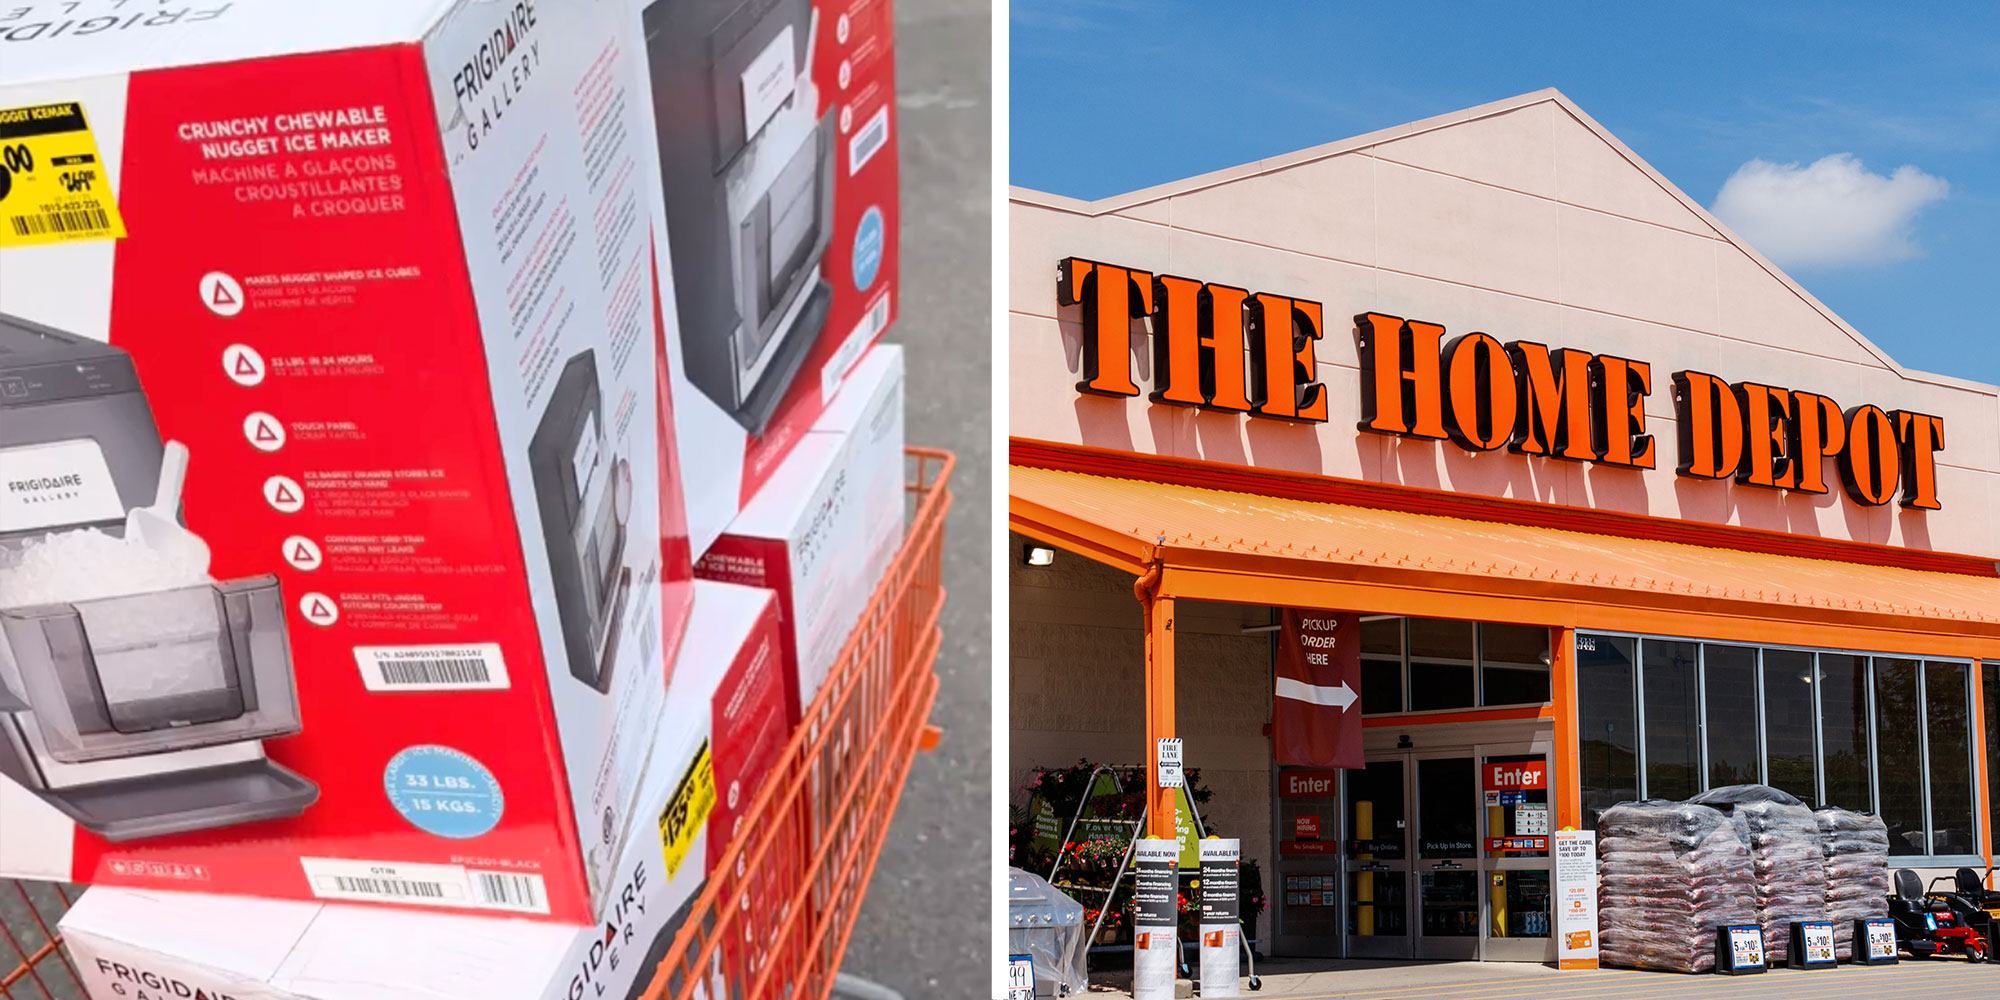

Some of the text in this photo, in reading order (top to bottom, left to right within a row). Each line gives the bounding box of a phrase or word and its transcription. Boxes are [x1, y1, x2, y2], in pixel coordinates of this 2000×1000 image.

[0, 3, 233, 41] FRIGID
[453, 0, 537, 101] FRIGIDAIRE
[467, 41, 540, 150] GALLERY
[178, 106, 387, 141] CRUNCHY CHEWABLE
[202, 128, 392, 160] NUGGET ICE MAKER
[192, 163, 279, 185] MACHINE
[303, 154, 397, 177] GLAÇONS
[234, 174, 403, 203] CROUSTILLANTES
[310, 194, 406, 217] CROQUER
[245, 275, 279, 286] MAKES
[281, 272, 322, 284] NUGGET
[324, 270, 365, 282] SHAPED
[366, 268, 384, 280] ICE
[1058, 256, 1947, 513] THE HOME DEPOT
[8, 474, 82, 493] FRIGIDAIRE
[23, 491, 79, 504] GALLERY
[705, 553, 765, 566] CHEWABLE
[727, 563, 766, 576] MAKER
[1302, 618, 1337, 631] PICKUP
[1301, 634, 1336, 648] ORDER
[1306, 652, 1328, 665] HERE
[405, 774, 476, 789] 33 LBS.
[1290, 776, 1331, 793] Enter
[1494, 767, 1541, 786] Enter
[412, 798, 482, 814] 15 KGS.
[370, 867, 396, 876] GTIN
[1734, 941, 1739, 951] 5
[1807, 937, 1812, 947] 5
[1870, 933, 1876, 943] 5
